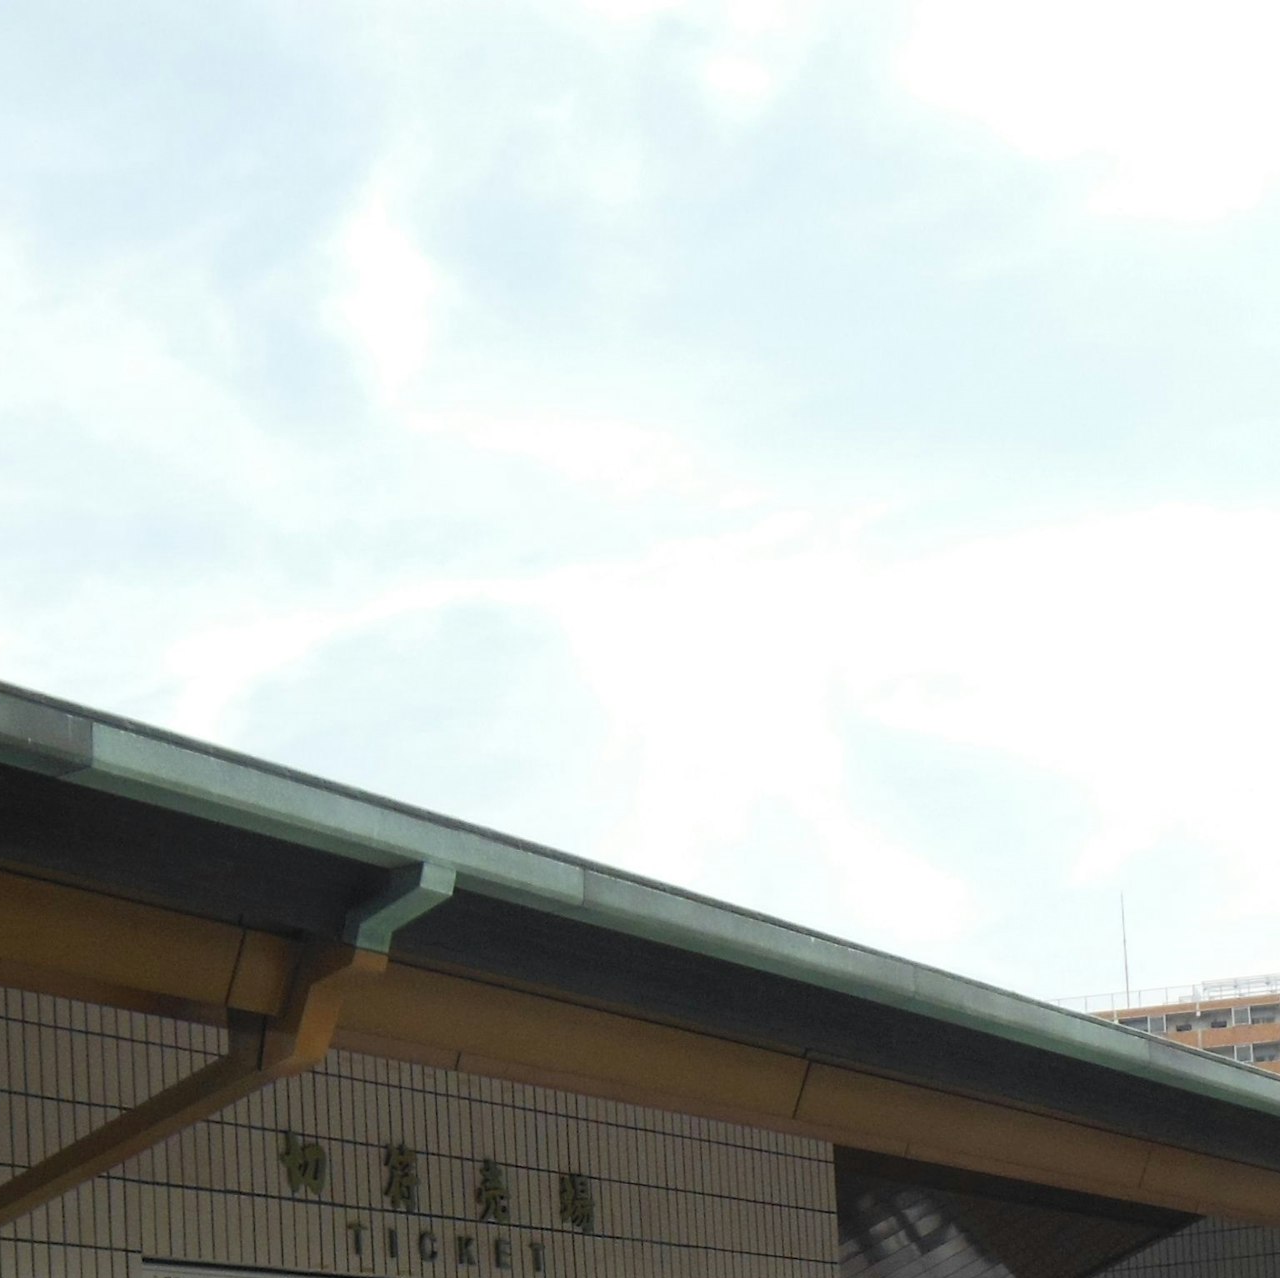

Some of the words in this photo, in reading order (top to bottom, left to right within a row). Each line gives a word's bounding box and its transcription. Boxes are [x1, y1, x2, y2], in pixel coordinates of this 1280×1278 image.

[280, 1131, 597, 1234] 切符売場
[346, 1220, 547, 1273] TICKET
